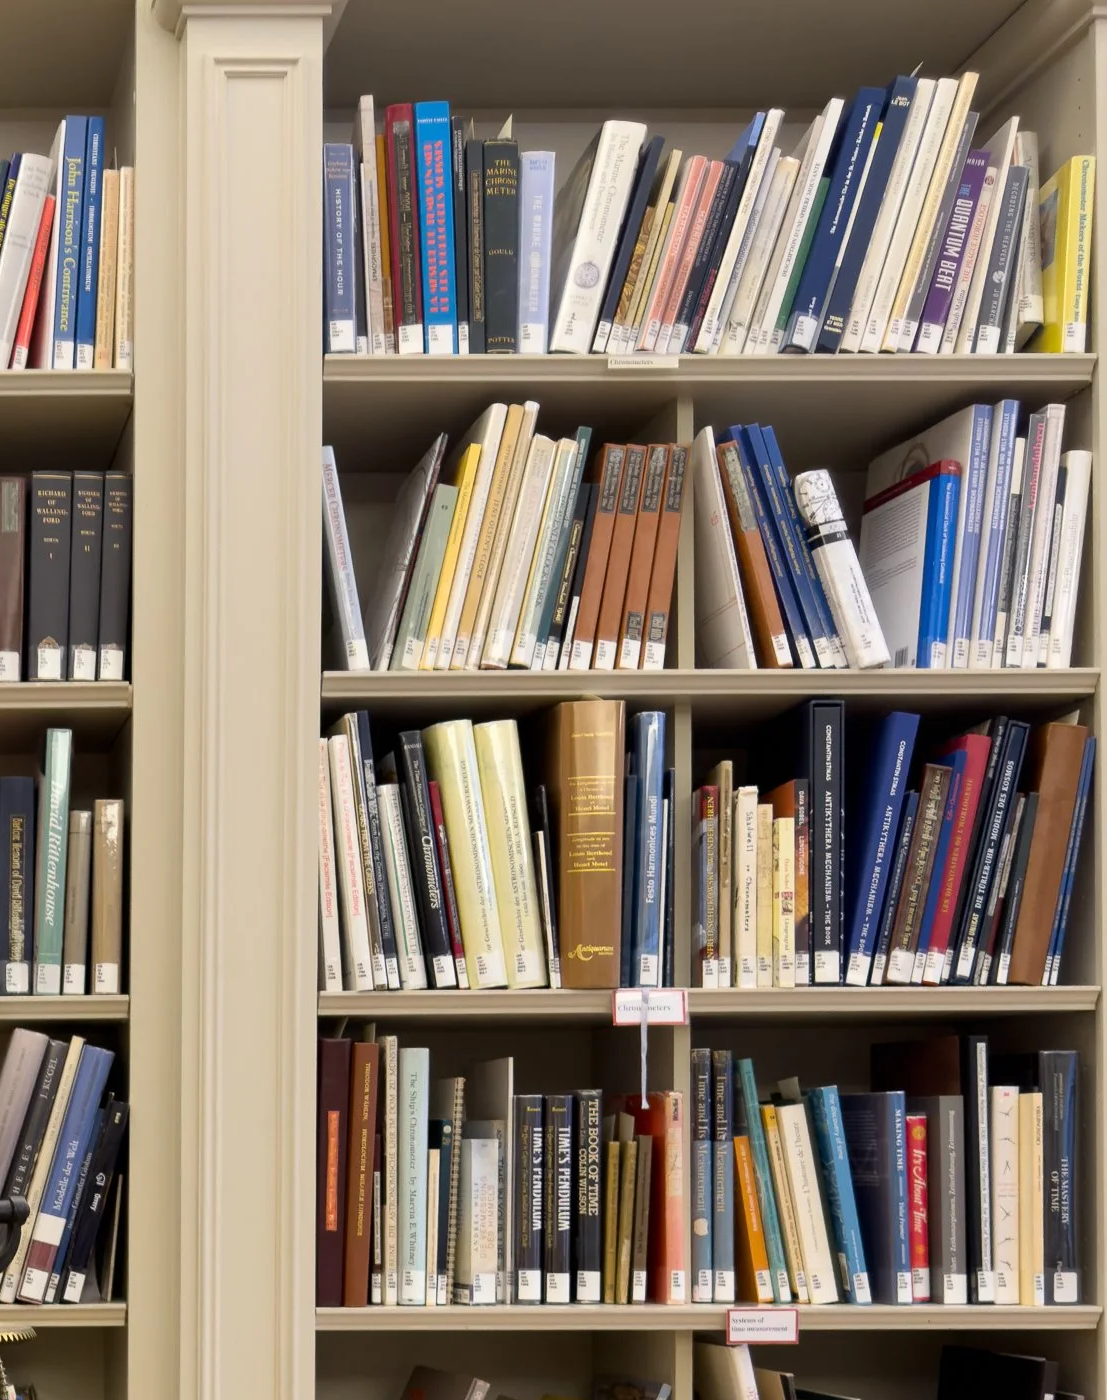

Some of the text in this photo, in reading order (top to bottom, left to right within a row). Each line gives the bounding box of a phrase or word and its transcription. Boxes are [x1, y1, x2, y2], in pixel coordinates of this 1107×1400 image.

[485, 177, 517, 186] CHRONO
[486, 167, 517, 176] MARINE
[486, 186, 516, 196] METER
[595, 133, 629, 244] The Marine Chronometer
[60, 156, 82, 331] John Harrison's Contrivance
[336, 232, 342, 243] OF
[934, 197, 973, 291] QUANTUM BEAT
[36, 508, 68, 516] WALLING-
[37, 490, 66, 498] RICHARD
[43, 516, 61, 524] FORD
[323, 463, 348, 571] MERCER CHRONOMETERS
[645, 795, 657, 903] Festo Harmonices Mundi
[824, 790, 832, 849] ANTIKYTHERA
[974, 759, 1014, 908] DIE TÜRLER-UHR MODELL DES KOSMOS
[44, 781, 64, 925] David Rittenhouse
[421, 835, 440, 909] Chronometers
[824, 852, 832, 901] MECHANISM
[408, 1090, 417, 1116] Ship's
[828, 1092, 845, 1160] the discovery of time
[894, 1108, 902, 1145] MAKING
[52, 1138, 79, 1211] Modelle der Welt
[409, 1117, 417, 1169] Chronometer
[587, 1098, 599, 1215] THE BOOK OF TIME
[696, 1072, 708, 1211] Time and Its Measurement
[716, 1073, 727, 1212] Time and Its Measurement
[408, 1176, 416, 1185] by
[532, 1127, 542, 1230] TIME'S PENDULUM
[557, 1125, 570, 1230] TIME'S PENDULUM
[578, 1148, 587, 1214] COLIN WILSON
[911, 1148, 926, 1233] It's About Time
[1051, 1170, 1059, 1212] OF TIME
[1060, 1158, 1069, 1223] THE MASTERY
[407, 1232, 416, 1265] Whitney
